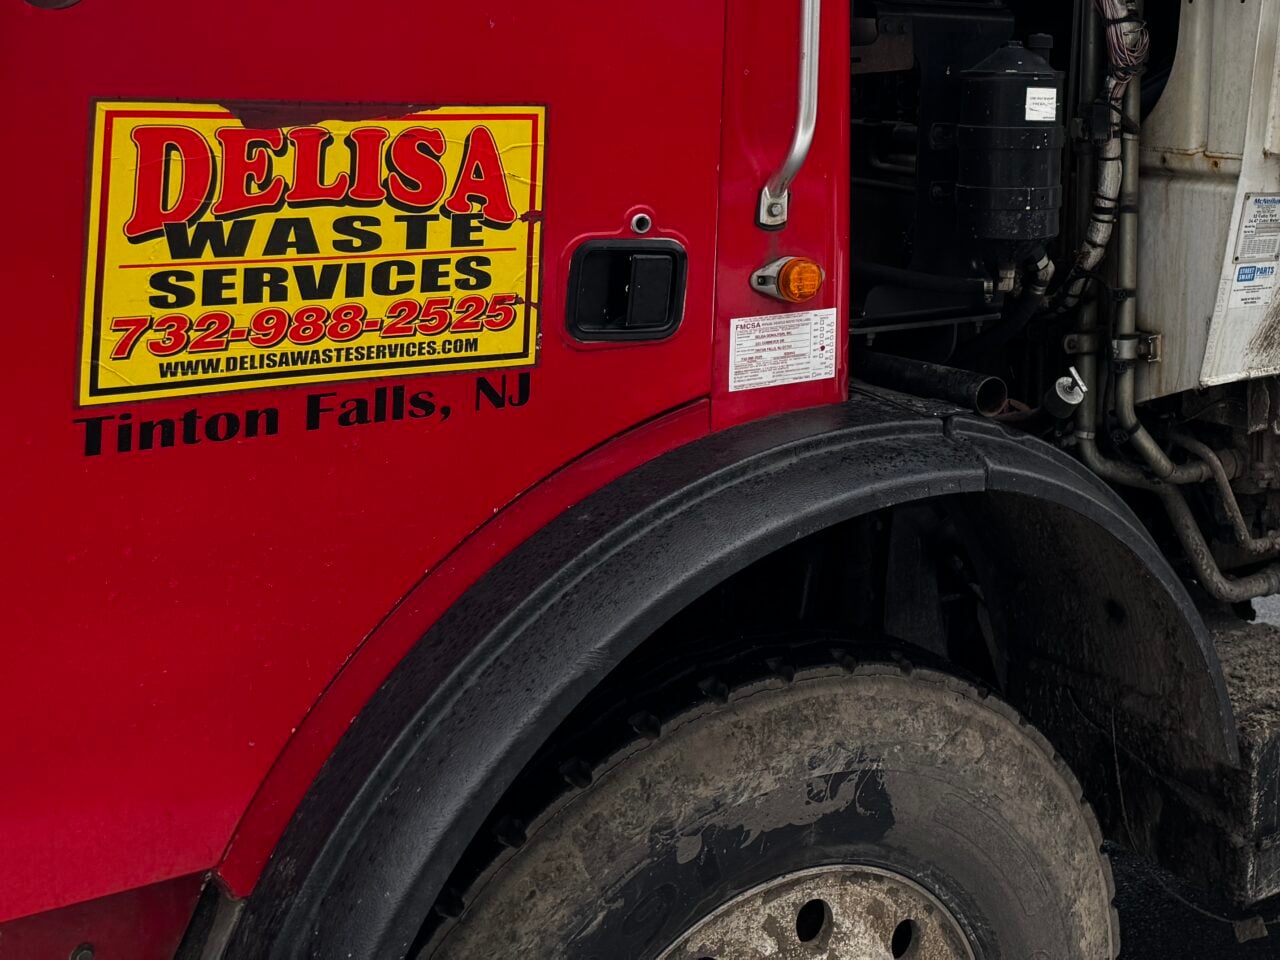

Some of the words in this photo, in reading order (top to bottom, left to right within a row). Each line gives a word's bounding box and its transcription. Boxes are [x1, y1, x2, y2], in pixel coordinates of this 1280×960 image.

[123, 124, 517, 243] DELISA
[162, 212, 485, 260] WASTE
[148, 255, 492, 309] SERVICES
[1256, 266, 1274, 275] PARTS
[110, 293, 517, 360] 732-988-2525
[736, 322, 761, 331] FMCSA
[159, 337, 478, 379] WWW.DELISAWASTESERVICES.COM
[73, 405, 279, 456] Tinton
[305, 385, 452, 431] Falls,
[475, 371, 531, 411] NJ
